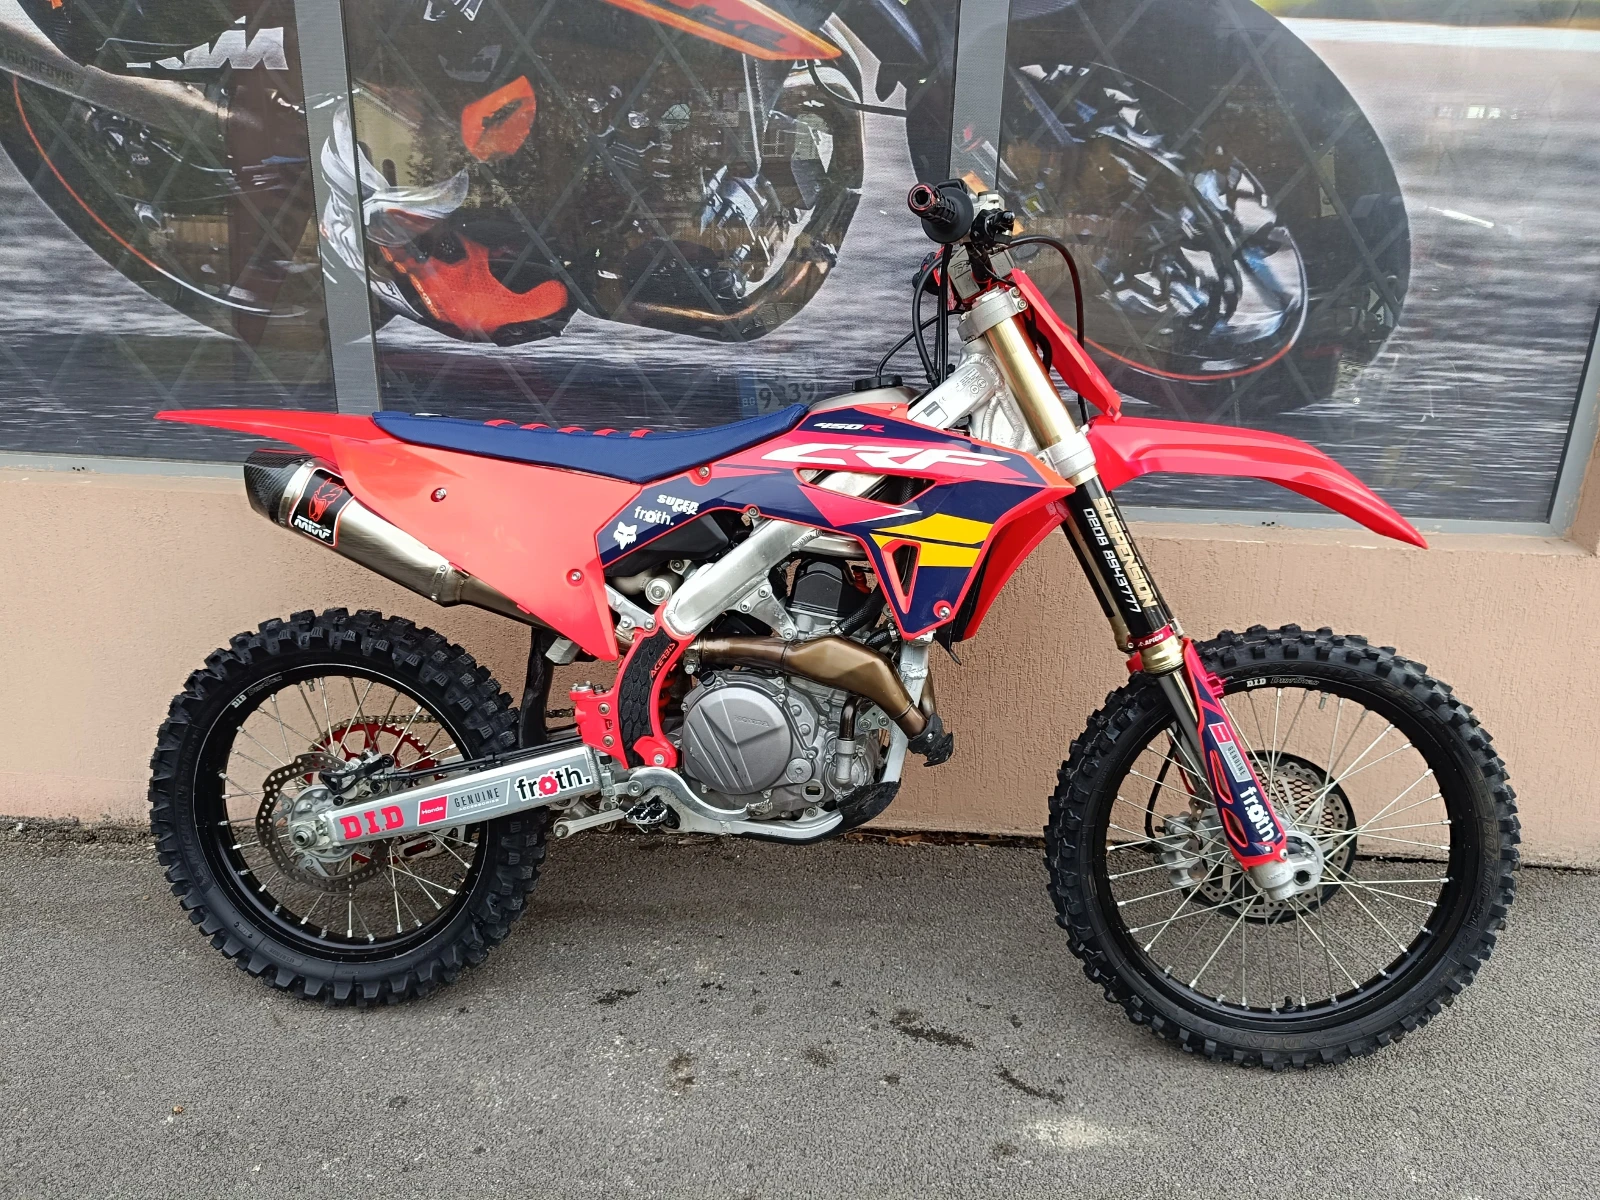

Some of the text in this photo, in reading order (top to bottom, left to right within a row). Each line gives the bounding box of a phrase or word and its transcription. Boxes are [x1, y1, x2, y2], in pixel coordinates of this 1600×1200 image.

[813, 422, 885, 433] 450R
[761, 443, 1011, 470] CRF
[1082, 507, 1110, 547] 0208
[1092, 497, 1158, 608] SUSPENSION
[650, 642, 676, 679] ACERBIS
[421, 806, 444, 815] Honda
[454, 787, 500, 808] GENUINE
